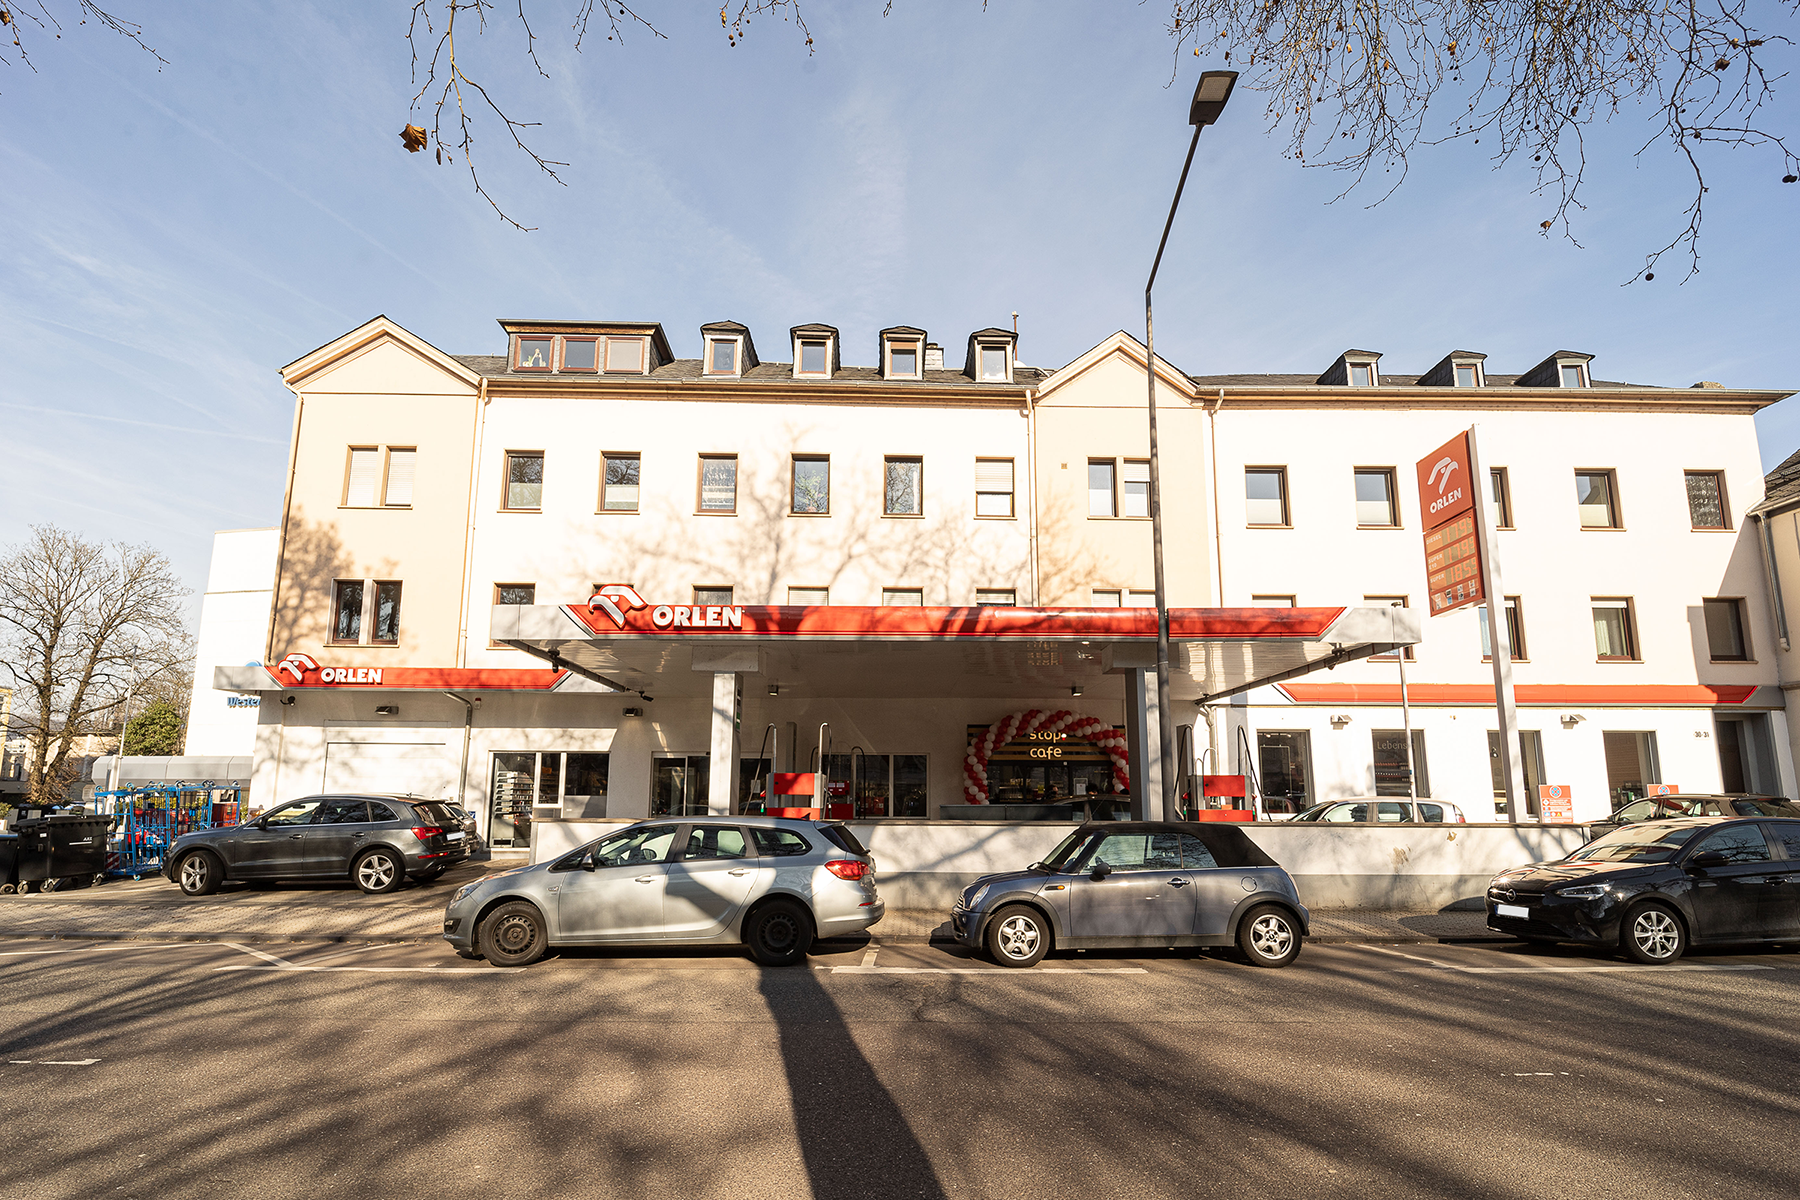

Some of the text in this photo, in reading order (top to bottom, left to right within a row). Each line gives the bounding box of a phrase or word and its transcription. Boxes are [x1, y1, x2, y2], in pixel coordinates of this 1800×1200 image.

[1430, 487, 1462, 514] ORLEN
[1428, 553, 1443, 564] SUPER
[1430, 573, 1445, 583] SUPER
[652, 605, 743, 627] ORLEN
[320, 667, 383, 683] ORLEN
[1029, 746, 1062, 760] cafe
